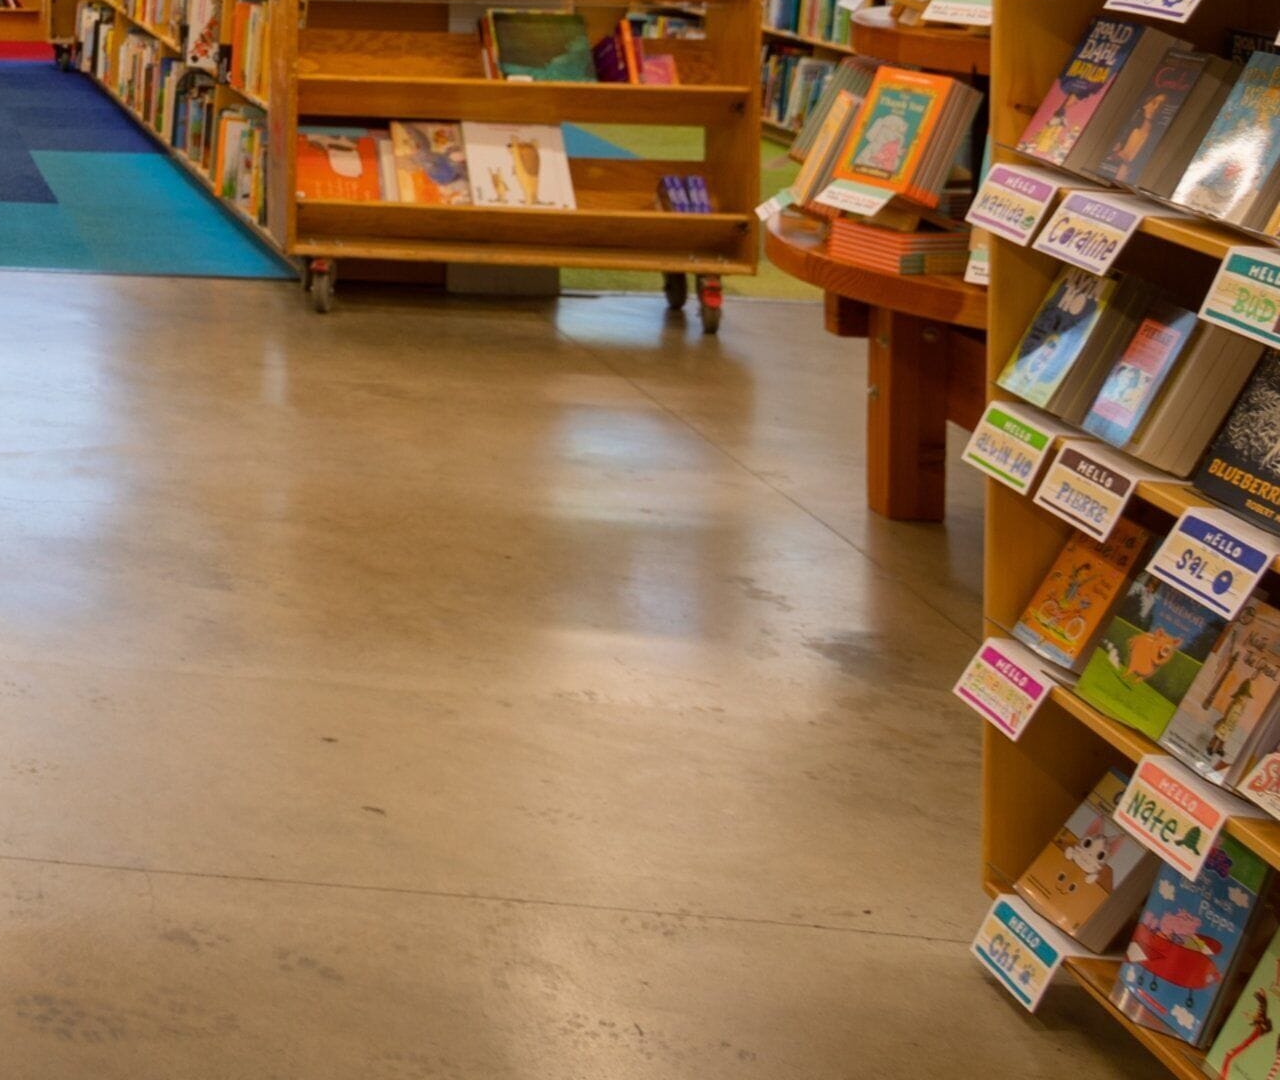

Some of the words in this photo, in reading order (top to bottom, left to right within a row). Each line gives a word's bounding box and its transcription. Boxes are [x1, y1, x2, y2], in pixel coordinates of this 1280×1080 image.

[1004, 175, 1037, 196] HELLO
[1002, 420, 1032, 443] HELLO
[1075, 459, 1114, 489] HELLO
[1202, 530, 1242, 559] HELLO
[1158, 776, 1198, 812] HELLO
[1008, 916, 1040, 951] HELLO
